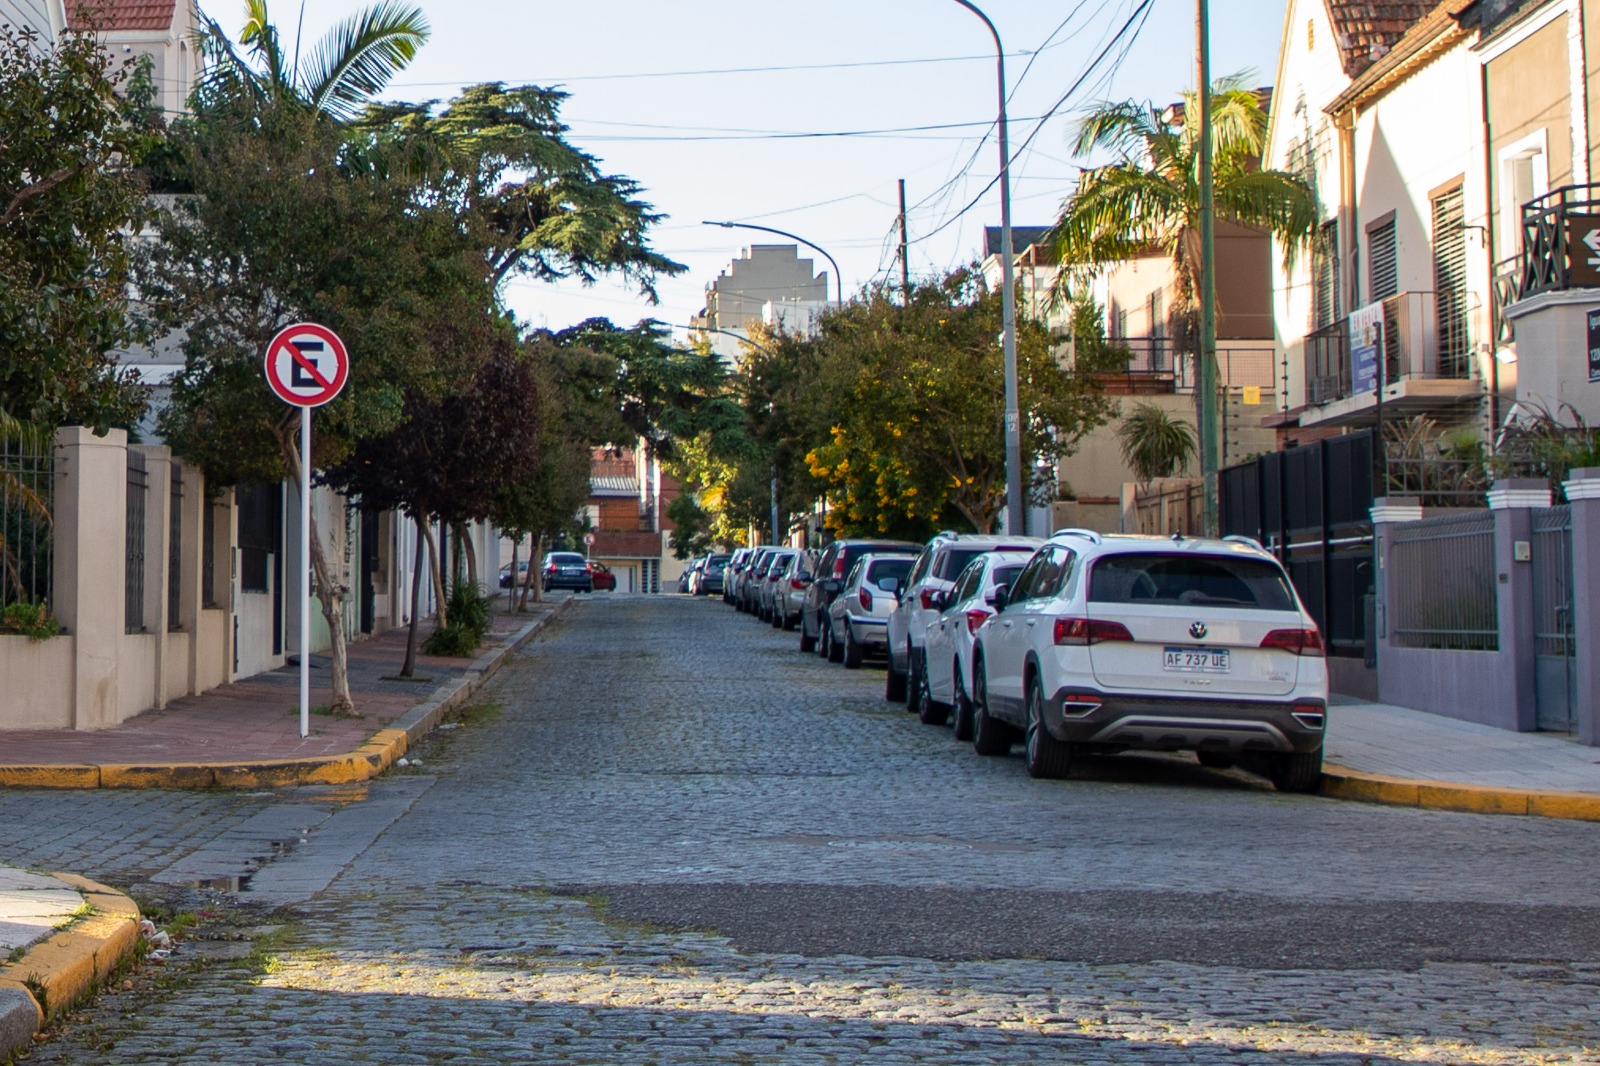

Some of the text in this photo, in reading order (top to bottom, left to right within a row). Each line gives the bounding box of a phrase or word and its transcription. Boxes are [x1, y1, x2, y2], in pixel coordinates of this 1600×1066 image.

[291, 341, 324, 388] E
[1167, 653, 1227, 667] AF 737 UE
